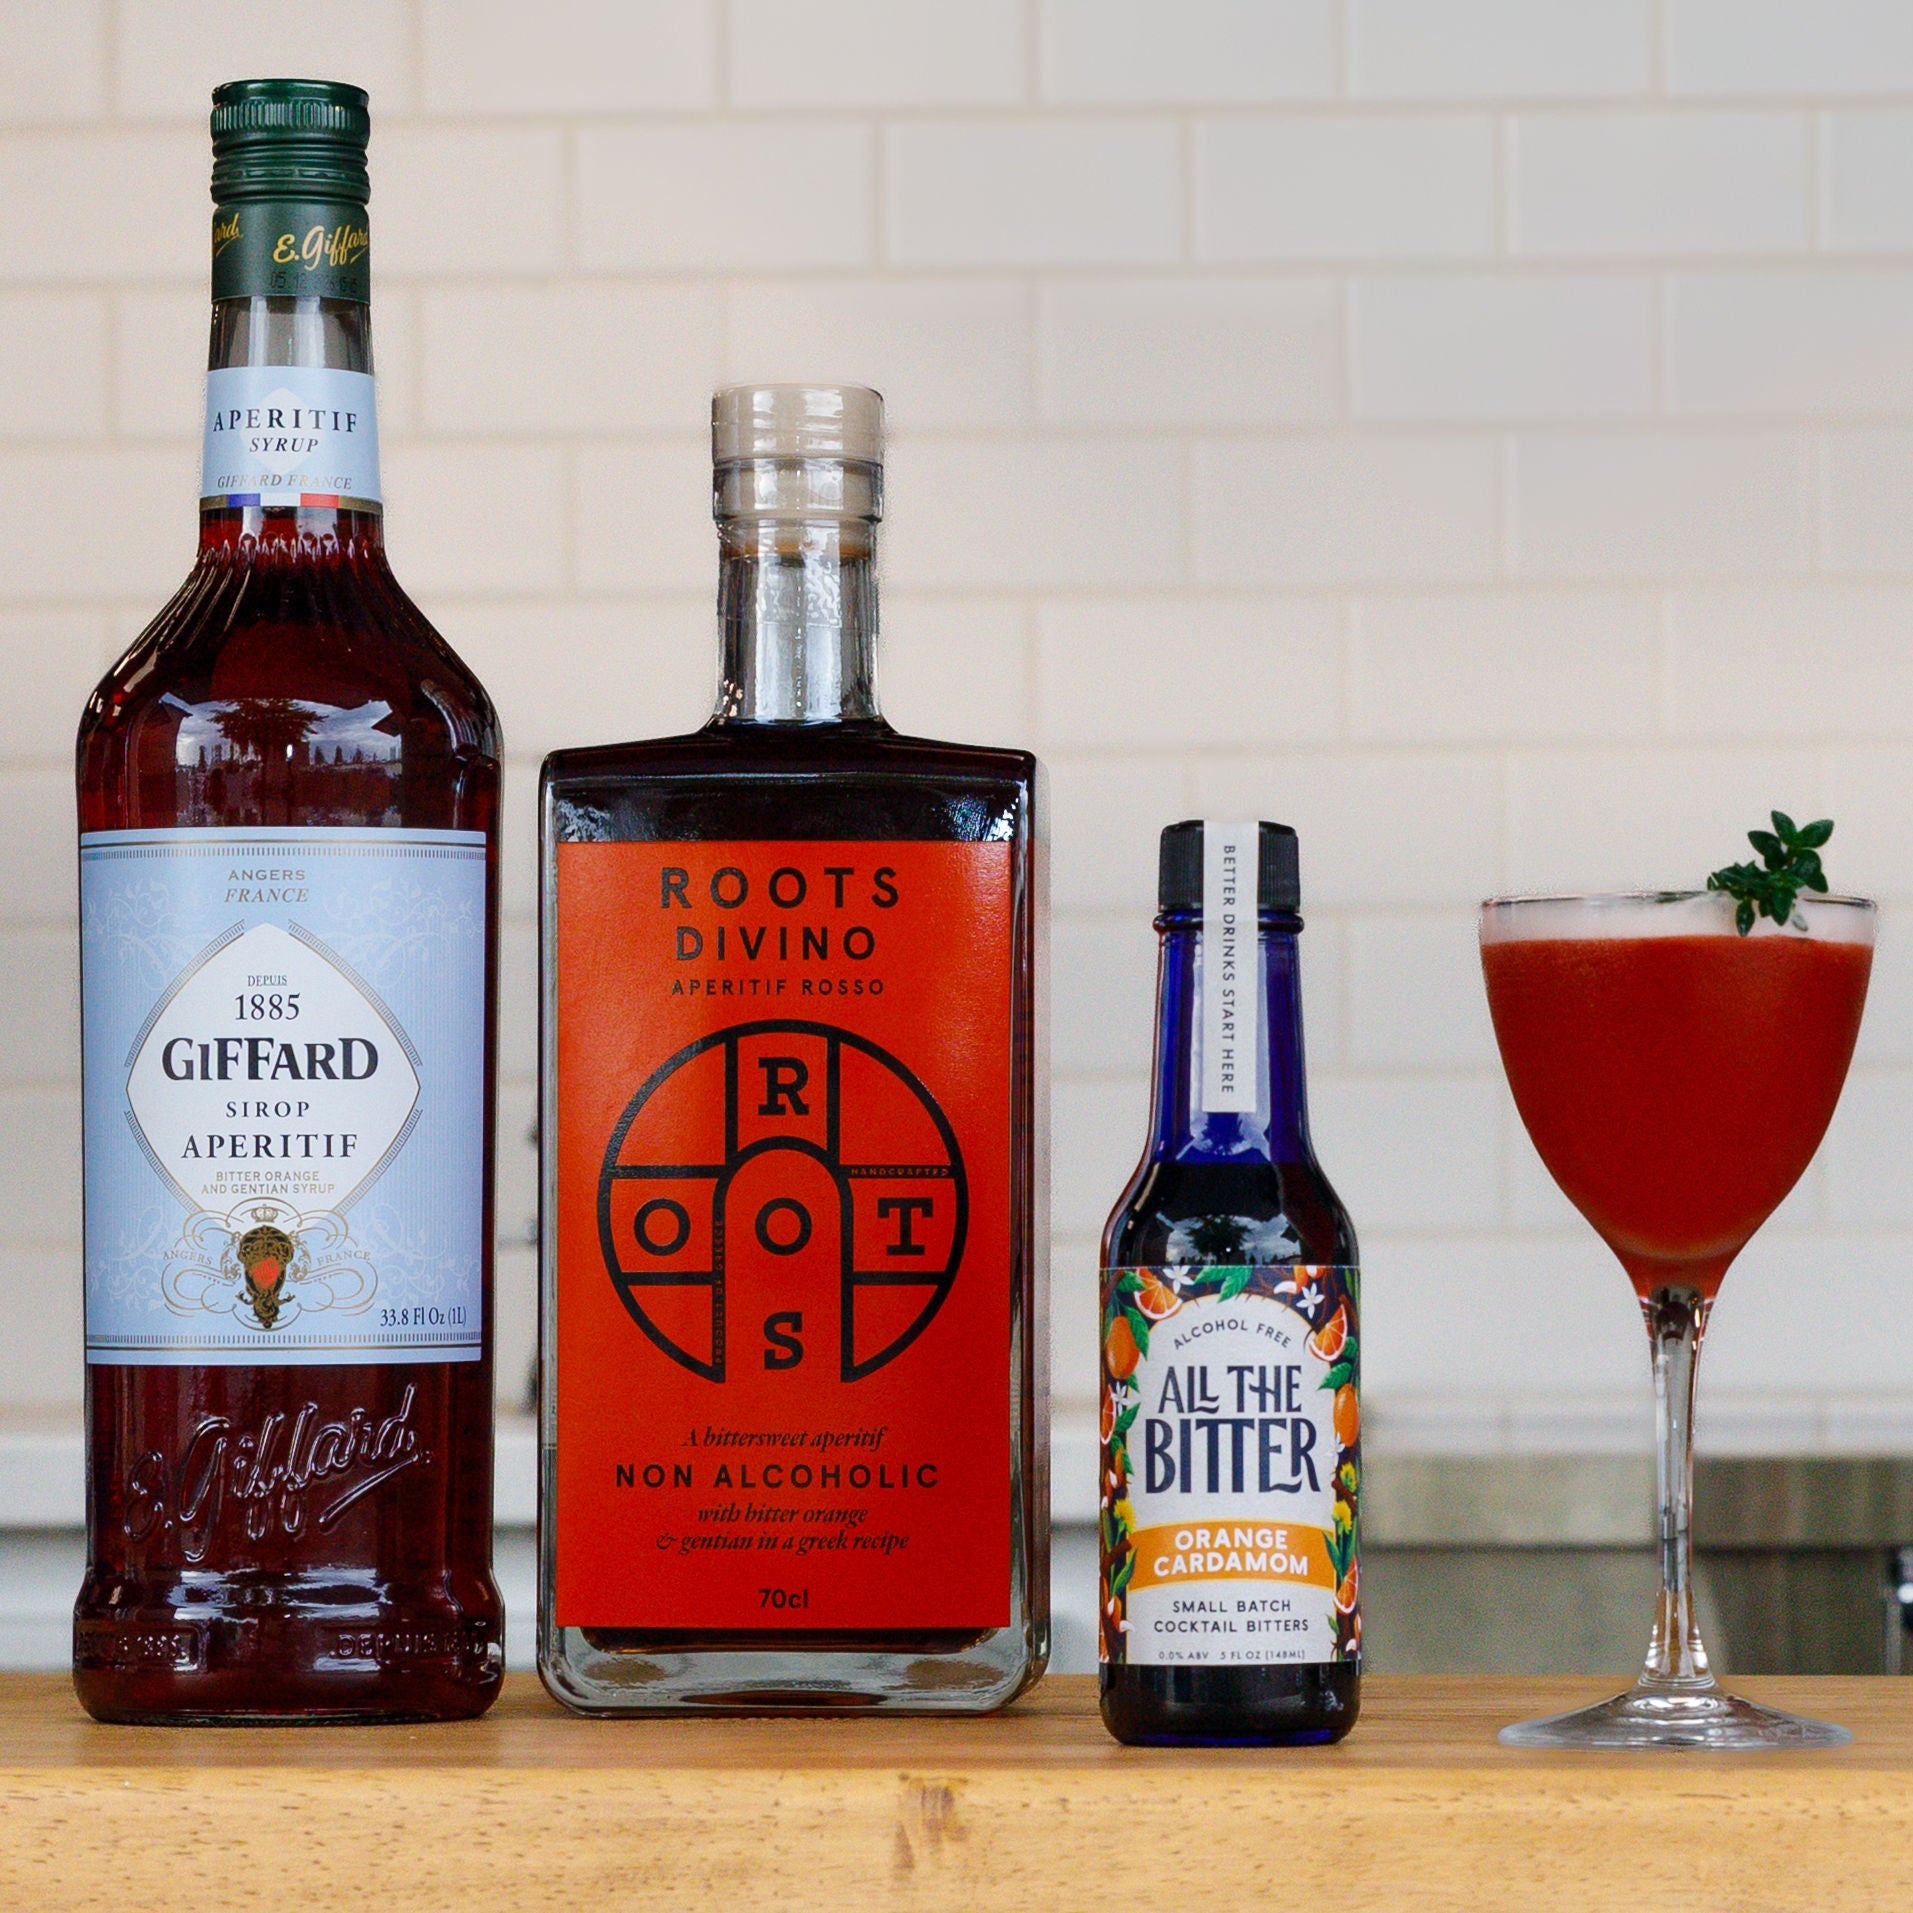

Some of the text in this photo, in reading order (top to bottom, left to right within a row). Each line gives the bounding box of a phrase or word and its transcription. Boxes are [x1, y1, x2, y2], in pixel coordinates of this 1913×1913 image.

[213, 408, 357, 433] APERITIF
[249, 437, 319, 452] SYRUP
[217, 474, 353, 490] GIFFARD FRANCE
[227, 869, 306, 881] ANGERS
[224, 888, 309, 903] FRANCE
[661, 867, 899, 909] ROOTS
[675, 926, 876, 960] DIVINO
[247, 974, 288, 987] DEPUIS
[1221, 845, 1237, 1093] BETTER DRINKS START HERE
[671, 979, 885, 996] APERITIF ROSSO
[234, 993, 300, 1021] 1885
[757, 1057, 809, 1116] R
[225, 1101, 310, 1118] SIROP
[181, 1133, 358, 1159] APERITIF
[215, 1170, 320, 1182] BITTER ORANGE
[851, 1167, 949, 1177] HANDCRAFTED
[201, 1183, 335, 1195] AND GENTIAN SYRUP
[633, 1198, 933, 1256] O O T
[162, 1250, 213, 1265] ANGERS
[316, 1250, 371, 1266] FRANCE
[380, 1308, 409, 1327] 33.8
[428, 1306, 445, 1326] Oz
[448, 1305, 467, 1328] (1L)
[763, 1311, 803, 1370] S
[1173, 1318, 1292, 1350] ALCOHOL FREE
[1157, 1365, 1303, 1414] ALL THE
[680, 1426, 888, 1452] A bittersweet aperitif
[1145, 1418, 1321, 1494] BITTER
[615, 1463, 939, 1489] NON ALCOHOLIC
[697, 1502, 869, 1527] with bitter orange
[656, 1529, 910, 1555] & gentian in a greek recipe
[1174, 1528, 1288, 1550] ORANGE
[1153, 1551, 1309, 1577] CARDAMOM
[758, 1588, 809, 1609] 70cl
[1172, 1599, 1291, 1613] SMALL BATCH
[1153, 1619, 1309, 1633] COCKTAIL BITTERS
[1158, 1651, 1184, 1660] 0.0%
[1187, 1651, 1209, 1659] ABV
[1230, 1651, 1242, 1659] FL
[1245, 1650, 1261, 1659] OZ
